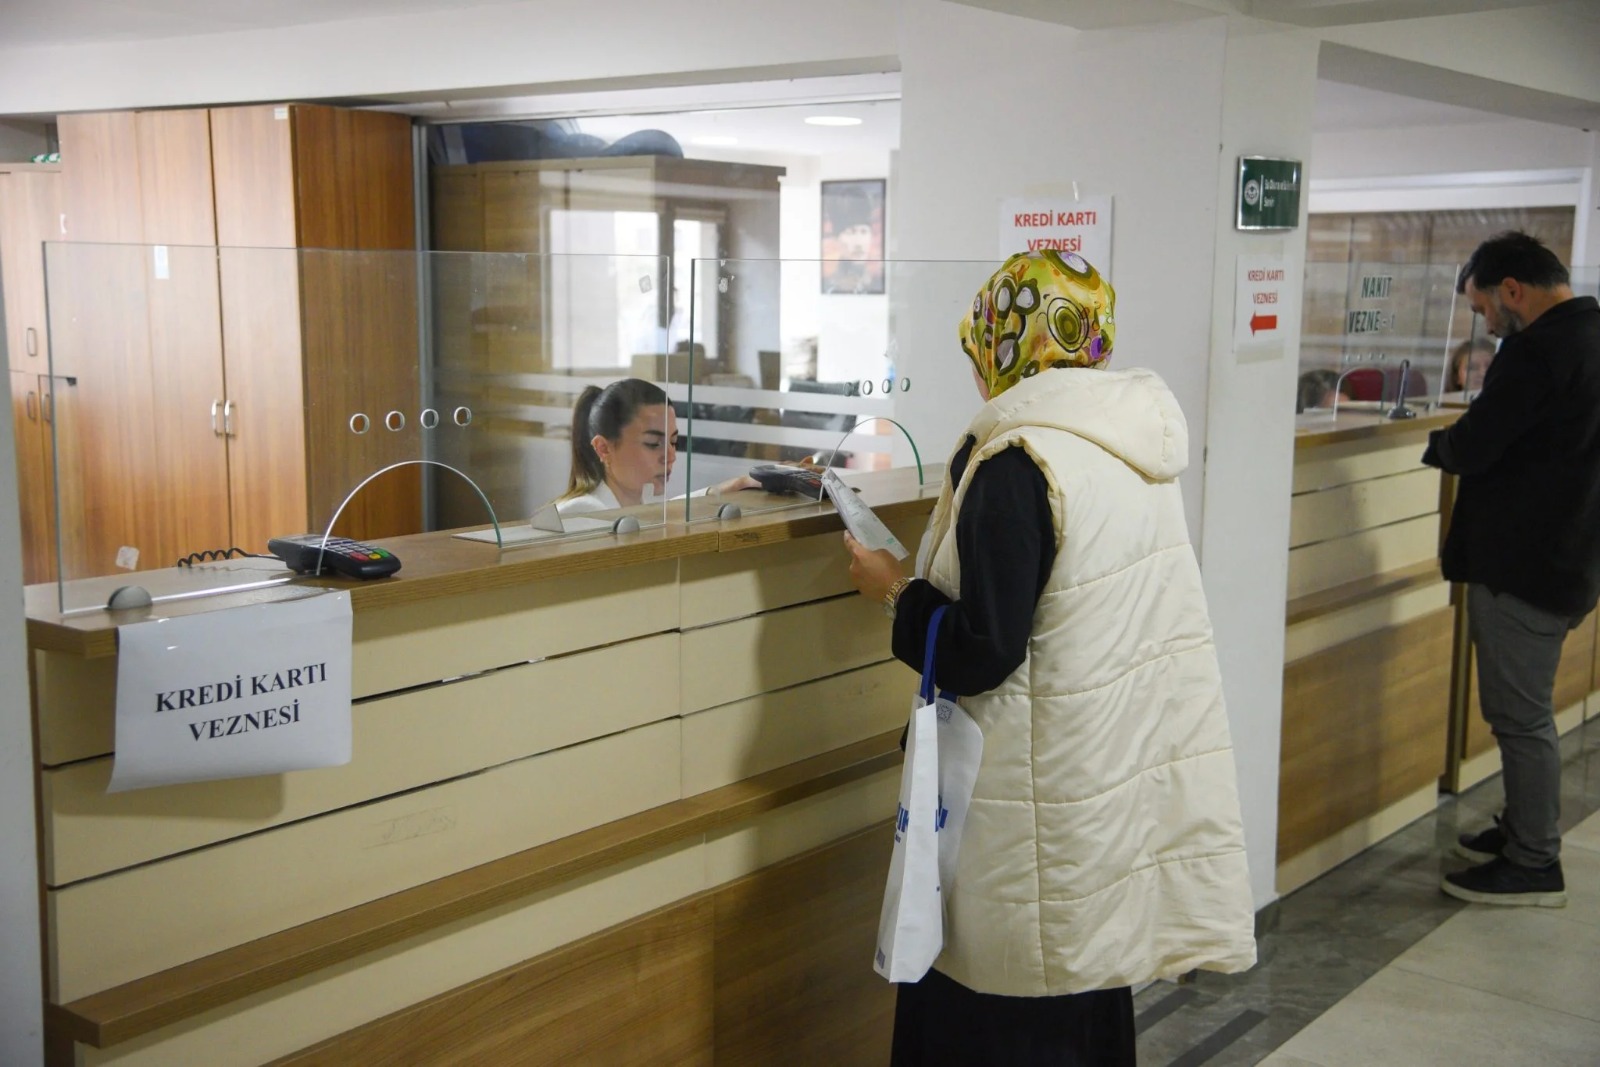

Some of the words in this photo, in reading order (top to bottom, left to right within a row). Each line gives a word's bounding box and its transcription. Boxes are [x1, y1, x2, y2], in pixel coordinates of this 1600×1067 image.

[1014, 209, 1053, 227] KREDİ
[1057, 211, 1097, 226] KARTI
[1026, 235, 1082, 252] VEZNESİ
[1348, 310, 1381, 333] VEZNE
[154, 674, 244, 712] KREDİ
[250, 662, 327, 696] KARTI
[188, 698, 301, 741] VEZNESİ
